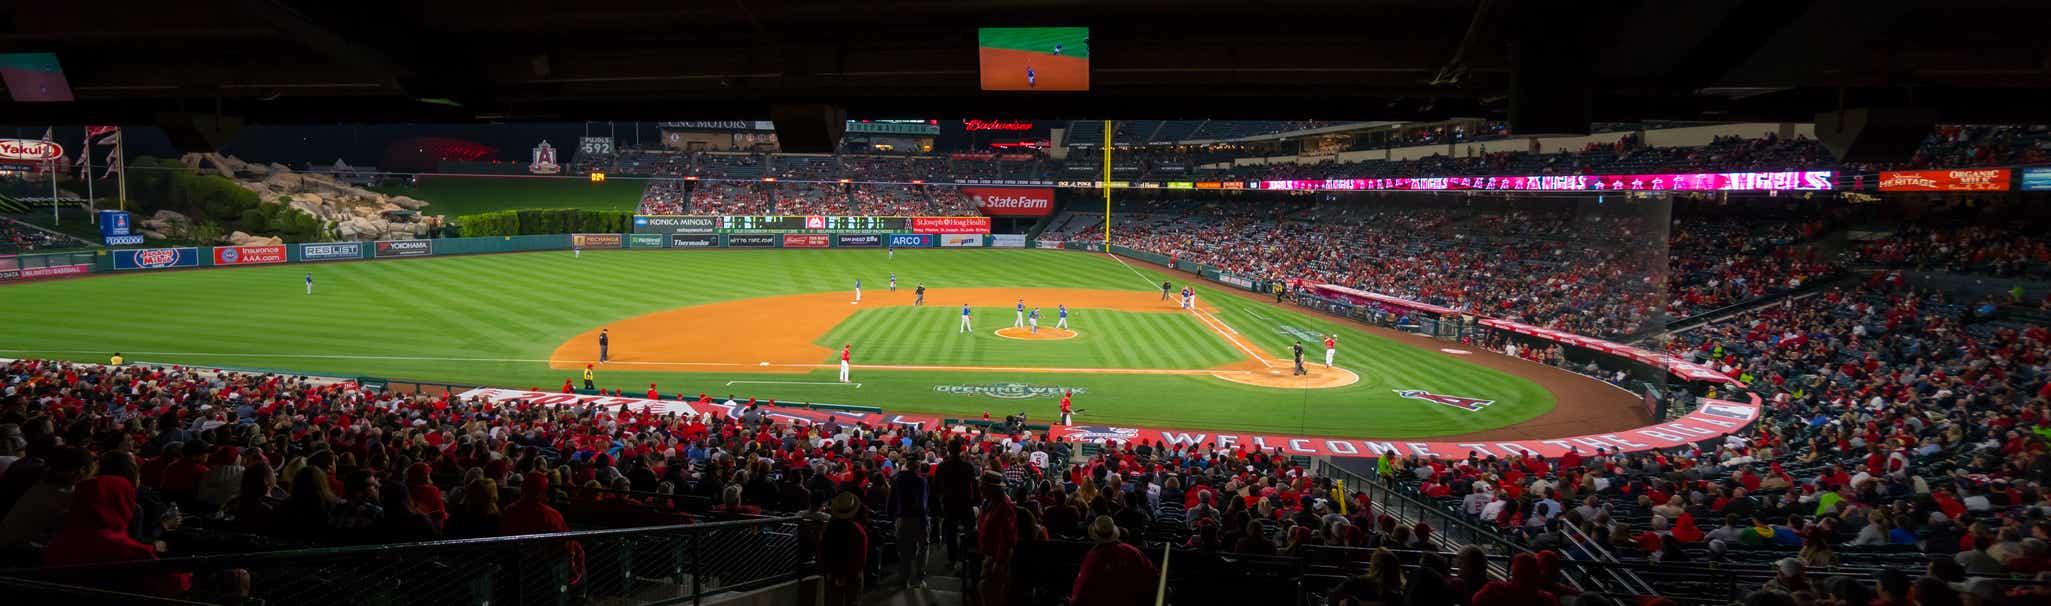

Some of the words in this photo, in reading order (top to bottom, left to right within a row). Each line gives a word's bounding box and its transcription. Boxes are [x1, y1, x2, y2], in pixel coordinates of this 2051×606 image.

[1949, 169, 2000, 179] ORGANIC
[1880, 178, 1937, 188] HERITAGE
[893, 237, 920, 245] ARCO
[933, 385, 1025, 394] OPENING
[1161, 431, 1440, 457] WELCOME
[1542, 434, 1649, 453] THE
[1637, 423, 1717, 442] BIG
